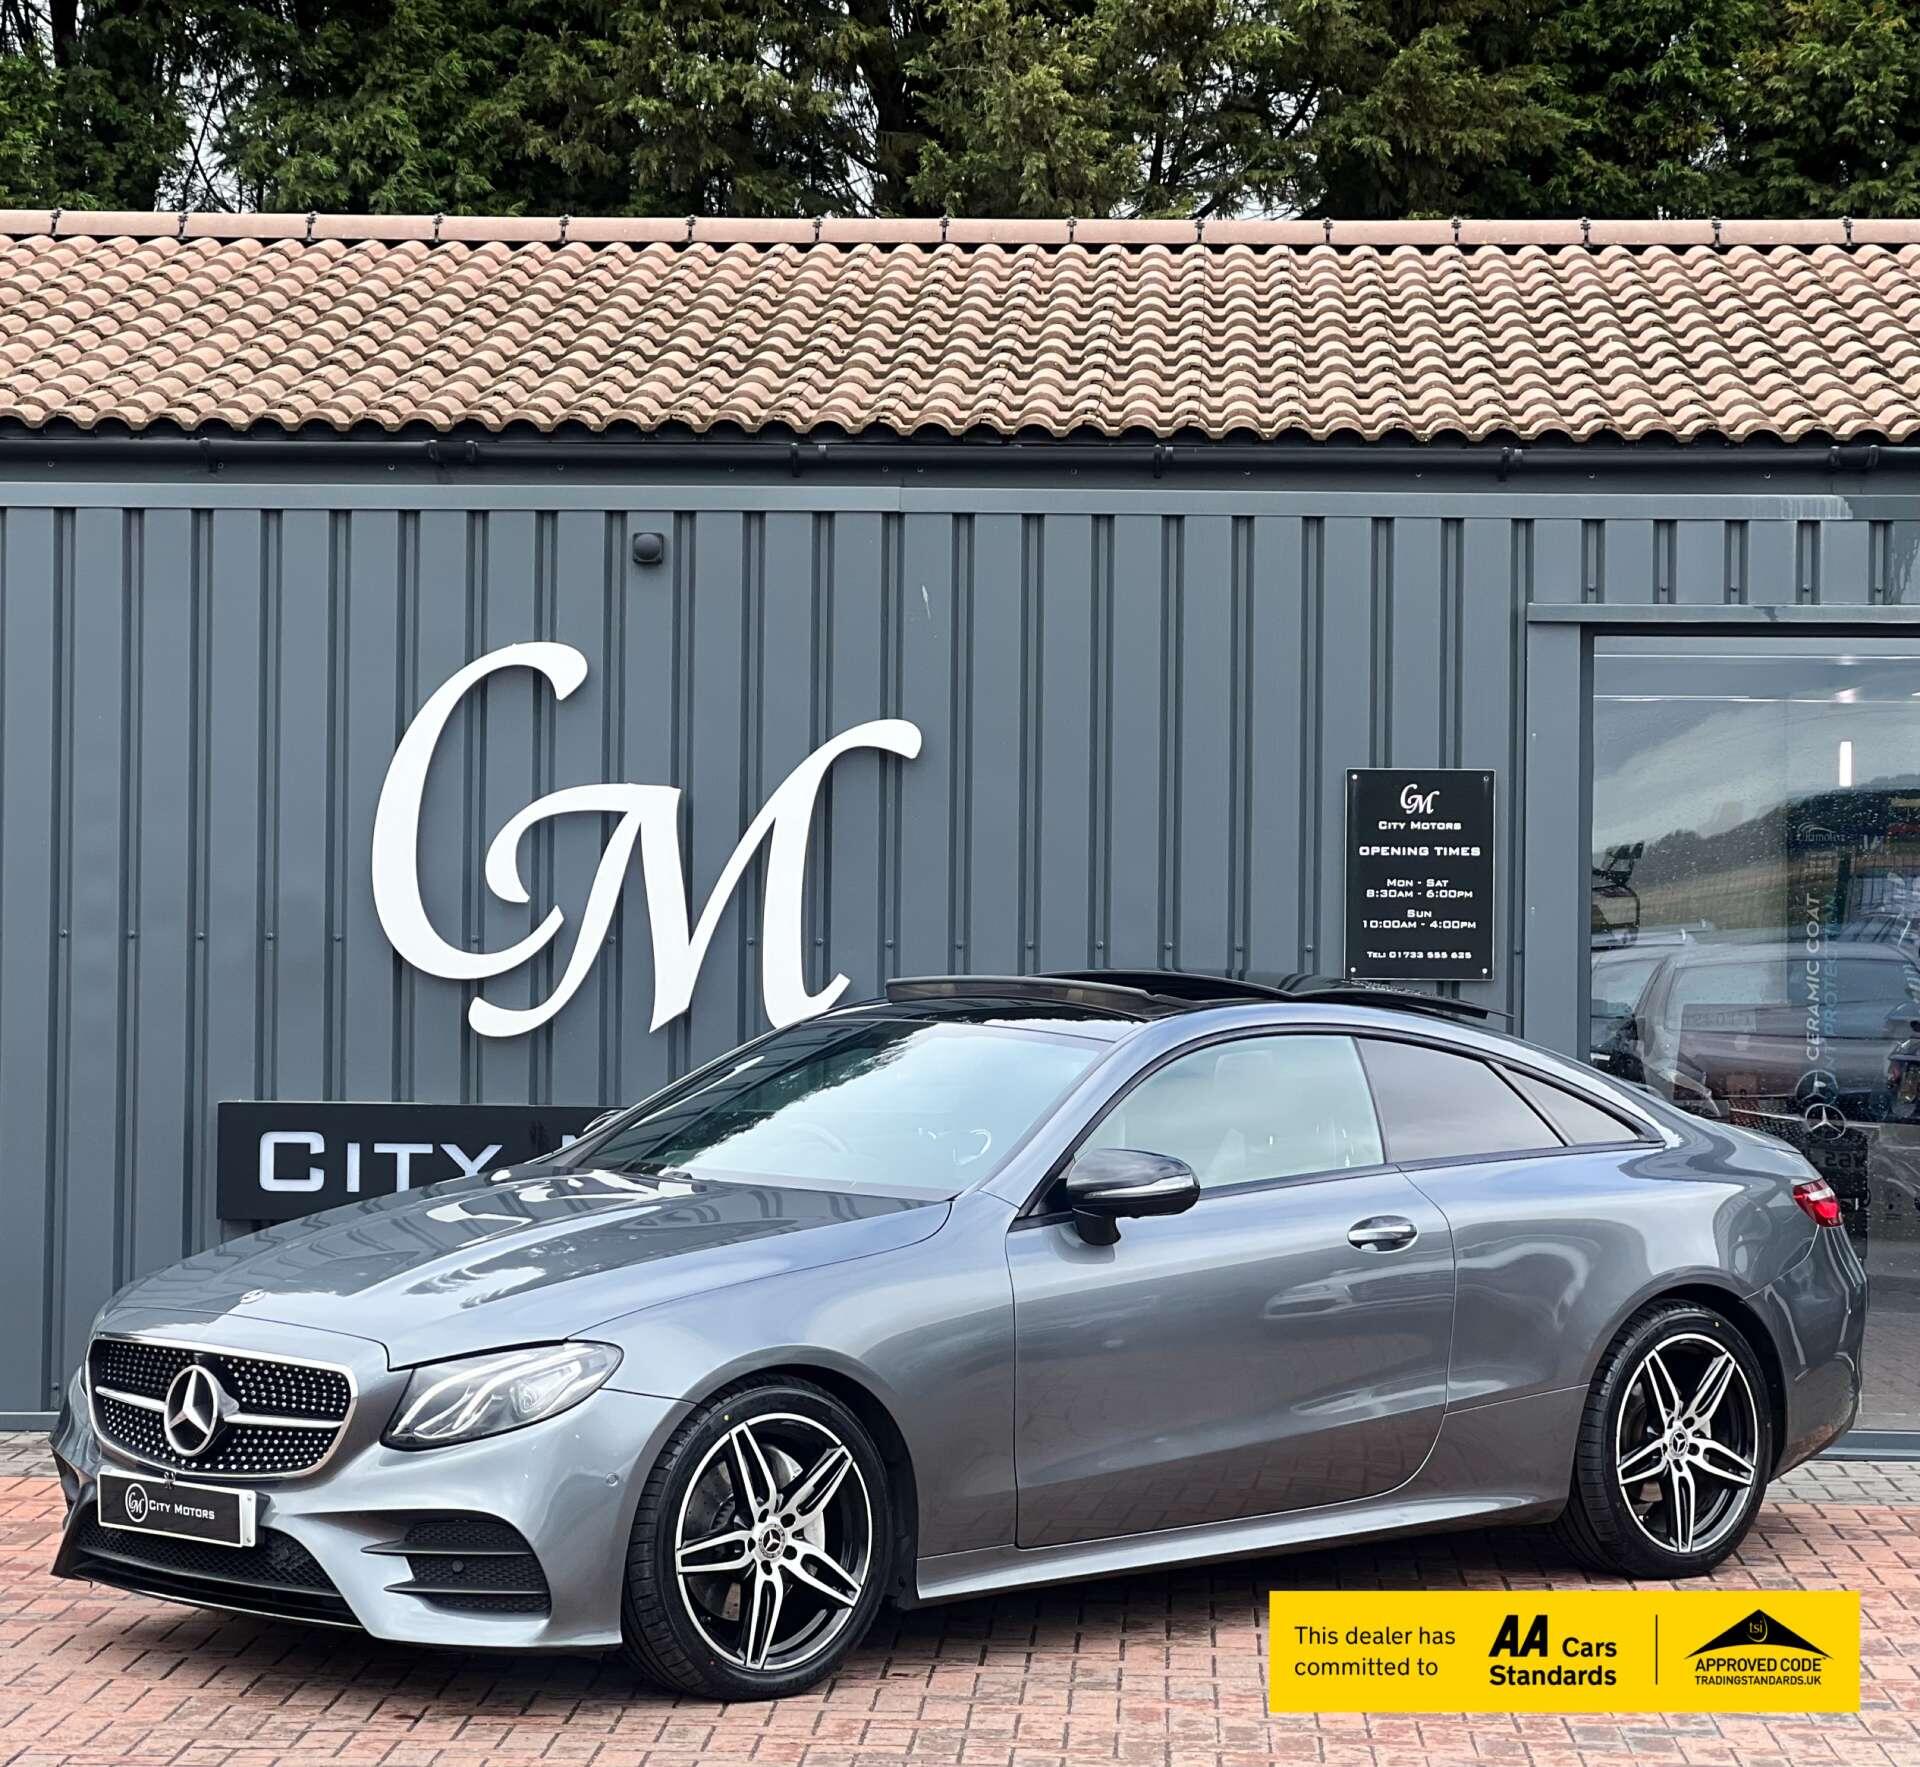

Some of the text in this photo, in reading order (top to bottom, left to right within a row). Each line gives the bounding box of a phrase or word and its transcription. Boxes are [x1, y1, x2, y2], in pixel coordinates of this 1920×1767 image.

[1378, 820, 1462, 831] CITY MOTORS
[1358, 846, 1481, 857] OPENING TIMES
[1386, 878, 1414, 888] MON
[1426, 878, 1449, 888] SAT
[1366, 888, 1414, 898] 8:30AM
[1425, 889, 1473, 899] 6:00PM
[1406, 909, 1432, 918] SUN
[1429, 920, 1477, 930] 4:00PM
[1806, 892, 1820, 1061] CERAMIC COAT
[259, 1131, 503, 1193] CITY
[149, 1500, 215, 1520] CITY MOTORS
